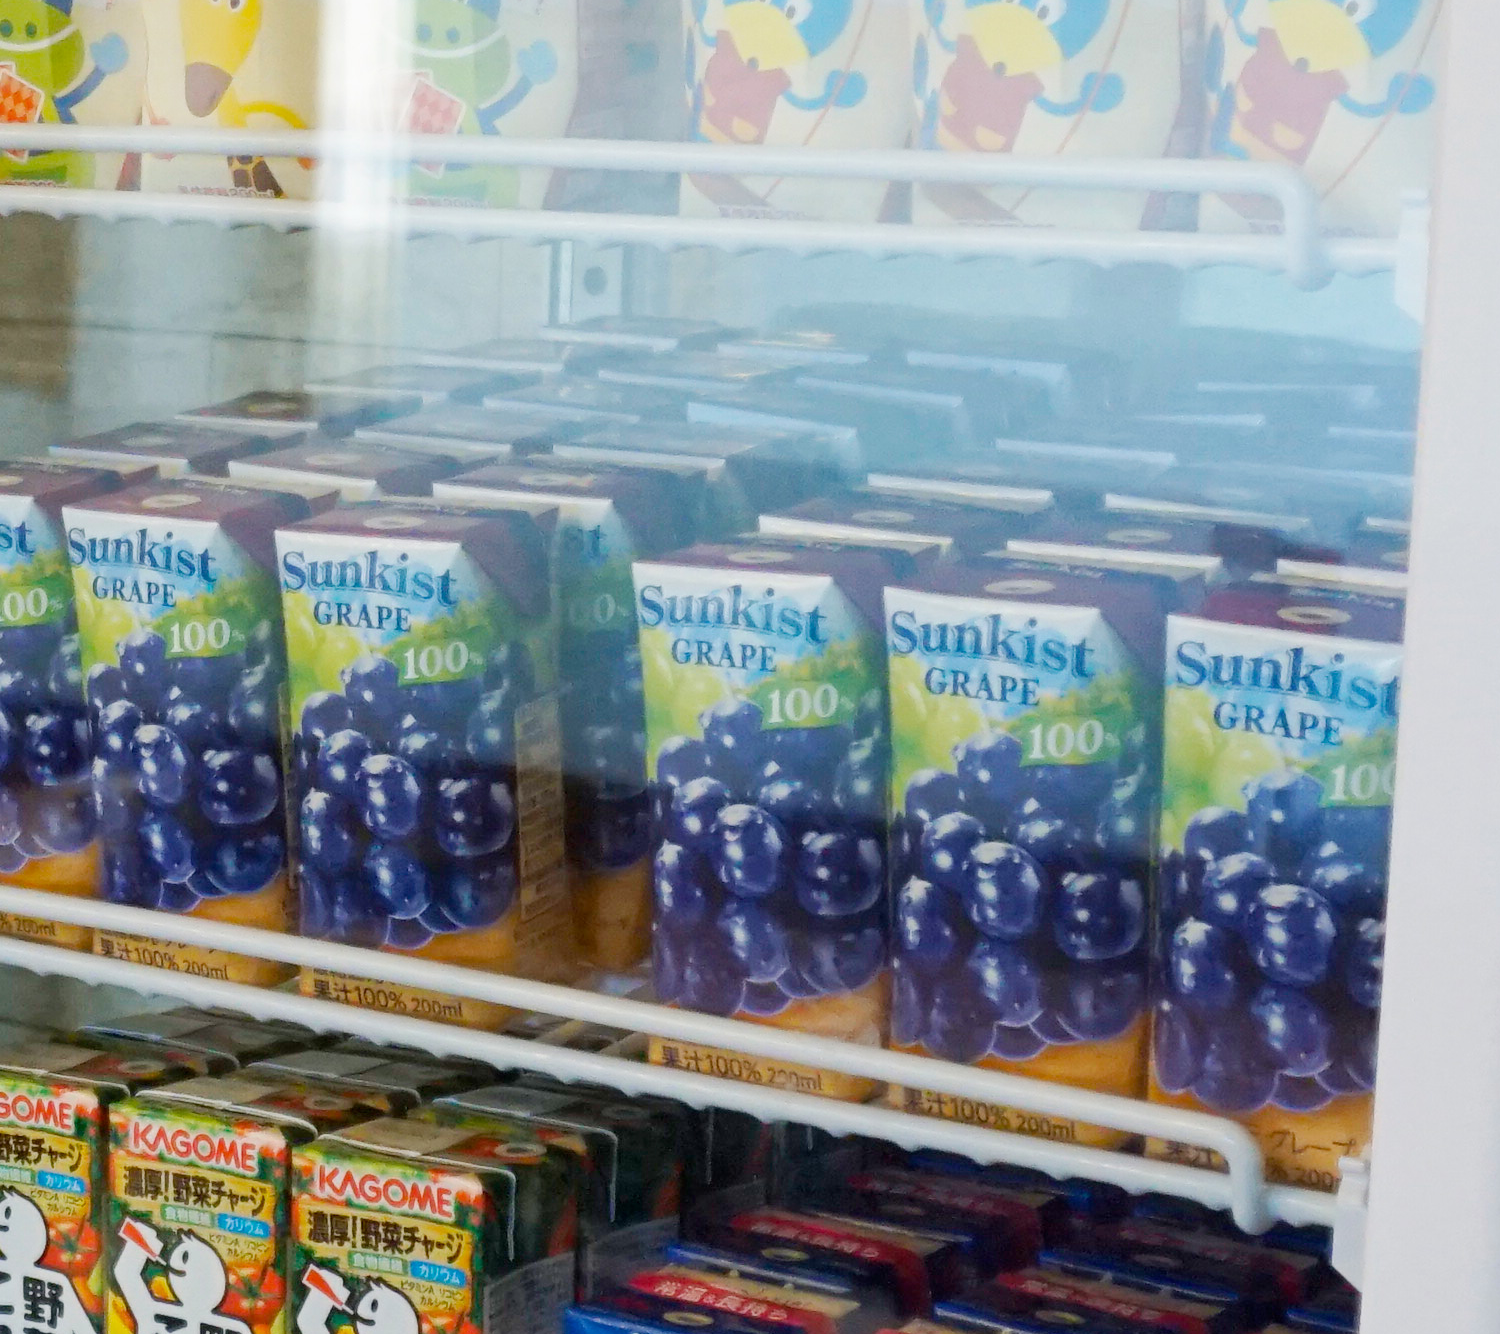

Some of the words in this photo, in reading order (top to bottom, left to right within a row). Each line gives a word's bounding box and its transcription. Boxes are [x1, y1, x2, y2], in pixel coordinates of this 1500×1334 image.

[68, 527, 218, 582] Sunkist
[92, 575, 177, 608] GRAPE
[283, 551, 457, 607] Sunkist
[314, 600, 412, 633] GRAPE
[640, 585, 828, 645] Sunkist
[671, 638, 777, 673] GRAPE
[891, 610, 1096, 679] Sunkist
[924, 666, 1041, 707] GRAPE
[1213, 701, 1345, 747] GRAPE
[100, 936, 180, 972] 果汁100%
[183, 959, 229, 980] 200ml
[313, 978, 407, 1012] 果汁100%
[411, 996, 464, 1019] 200ml
[662, 1045, 763, 1082] 果汁100%
[133, 1122, 257, 1173] KAGOME
[1016, 1113, 1077, 1141] 200ml
[45, 1175, 82, 1194] カリウム
[319, 1165, 453, 1218] KAGOME
[225, 1217, 265, 1236] カリウム
[418, 1263, 461, 1285] カリウム
